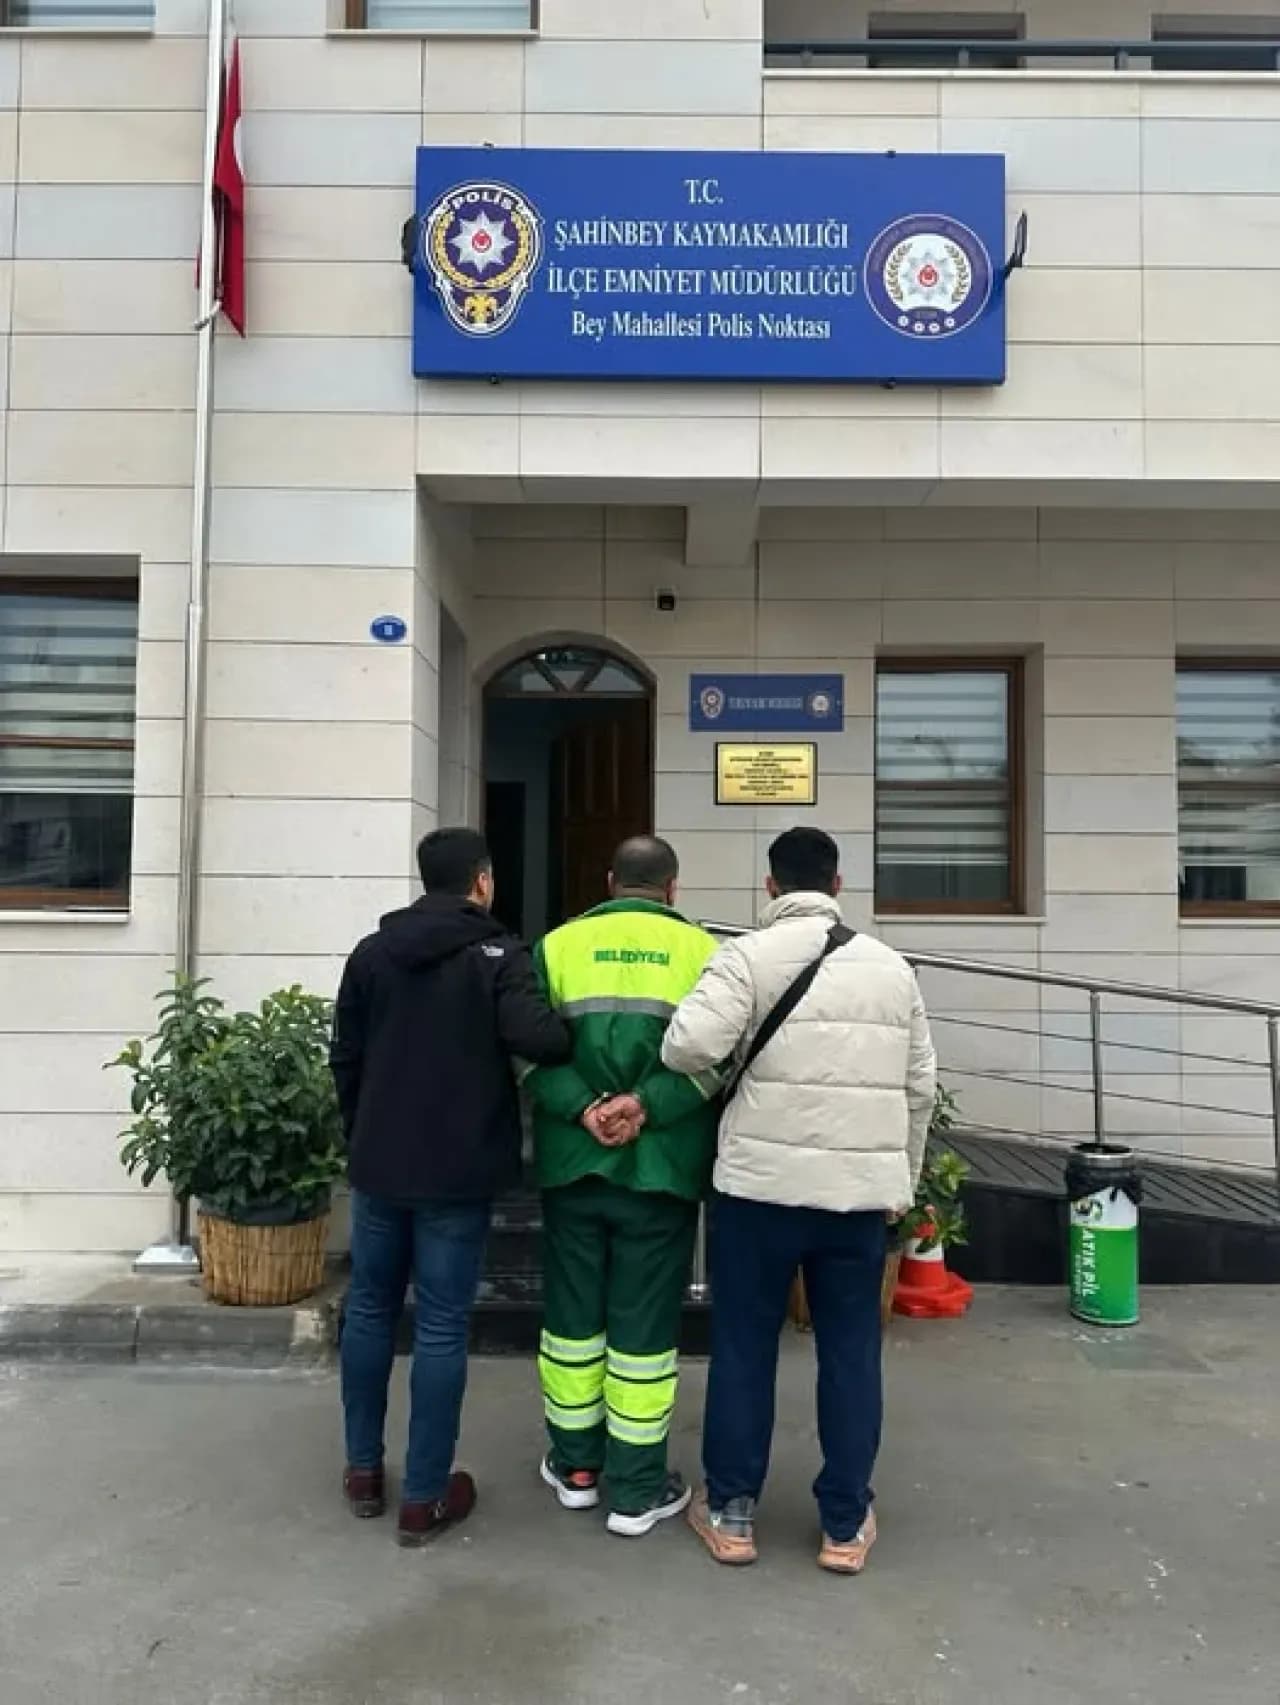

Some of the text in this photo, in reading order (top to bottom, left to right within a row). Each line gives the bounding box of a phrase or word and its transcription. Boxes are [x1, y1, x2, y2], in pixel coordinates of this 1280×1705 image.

[452, 191, 511, 209] POLİS
[684, 179, 724, 204] T.C.
[554, 216, 668, 251] ŞAHİNBEY
[673, 218, 848, 248] KAYMAKAMLIĞI
[547, 261, 857, 299] İLÇE EMNİYET MÜDÜRLÜĞÜ
[572, 310, 831, 342] Bey Mahallesi Polis Noktası
